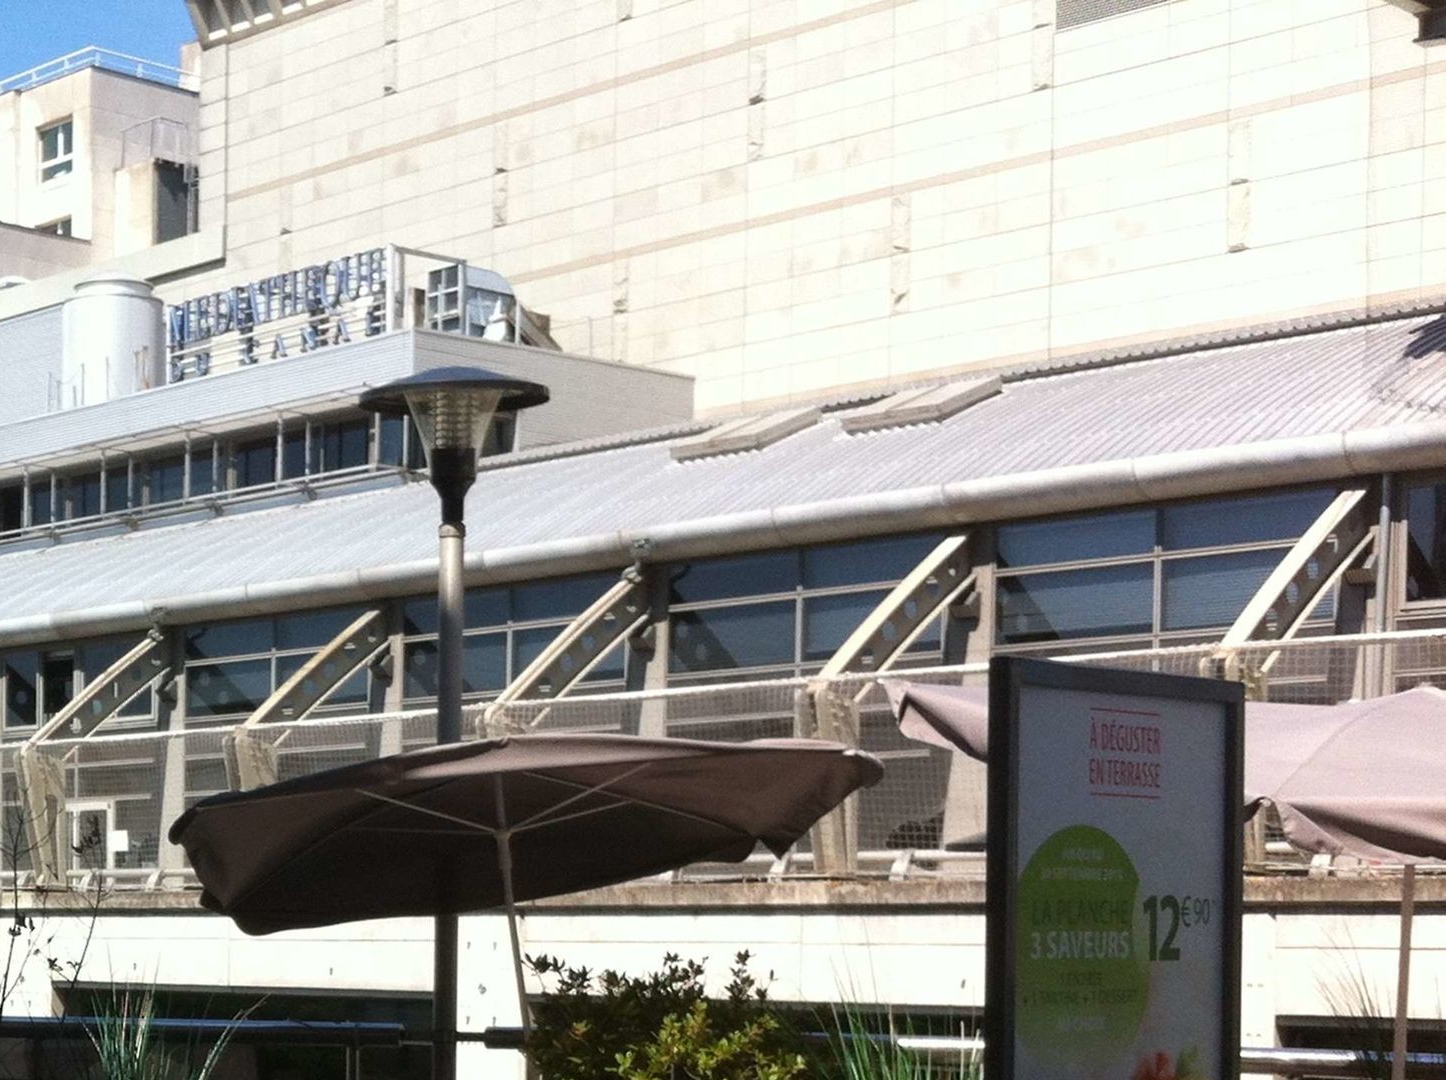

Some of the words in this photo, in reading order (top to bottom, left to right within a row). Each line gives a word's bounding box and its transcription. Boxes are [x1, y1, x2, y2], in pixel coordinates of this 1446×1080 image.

[1089, 716, 1099, 750] À
[1101, 719, 1161, 755] DÉGUSTER
[1089, 758, 1105, 786] EN
[1107, 760, 1161, 788] TERRASSE
[1030, 931, 1042, 960] 3
[1046, 930, 1131, 960] SAVEURS
